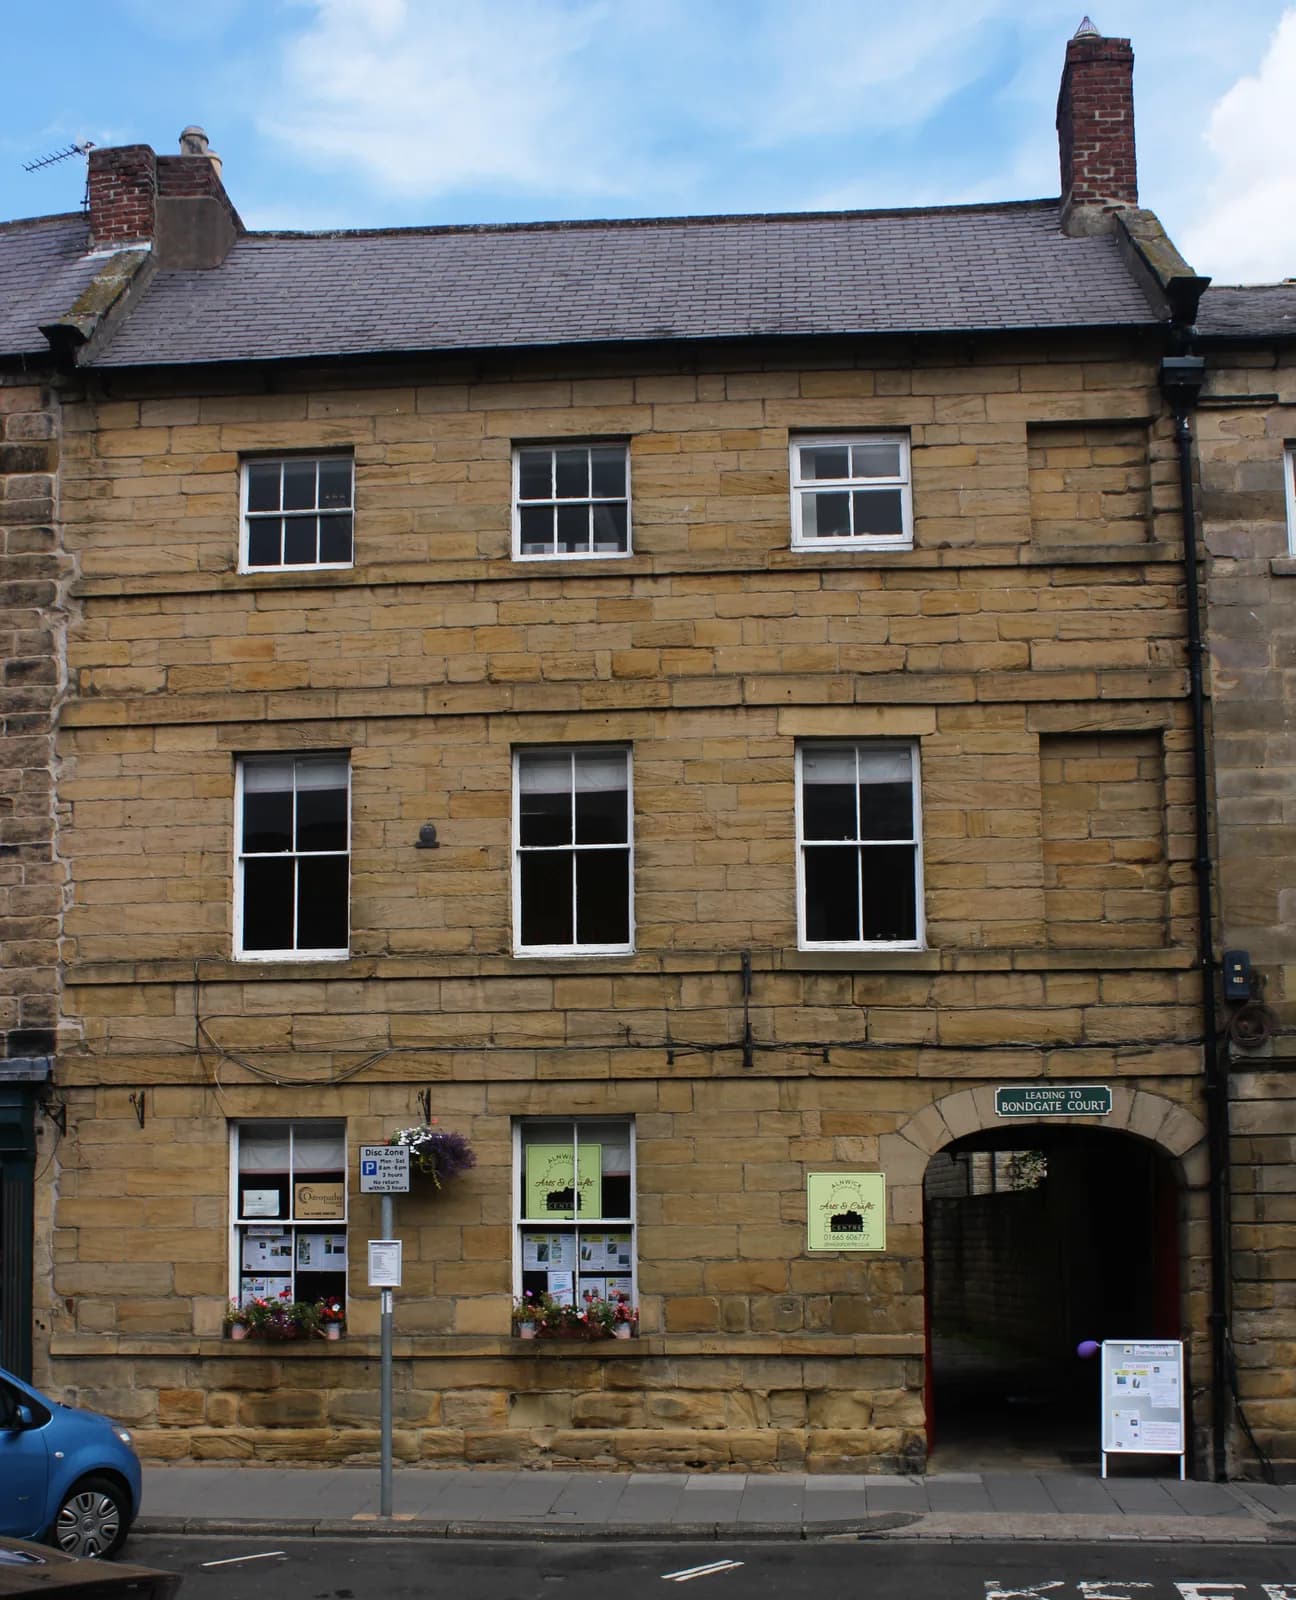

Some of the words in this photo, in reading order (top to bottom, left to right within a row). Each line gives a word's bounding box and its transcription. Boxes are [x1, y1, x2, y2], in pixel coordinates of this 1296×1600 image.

[1025, 1091, 1065, 1100] LEADING
[1069, 1090, 1082, 1099] TO
[1002, 1101, 1062, 1112] BONDGATE
[1067, 1100, 1105, 1111] COURT
[384, 1148, 404, 1156] Zone
